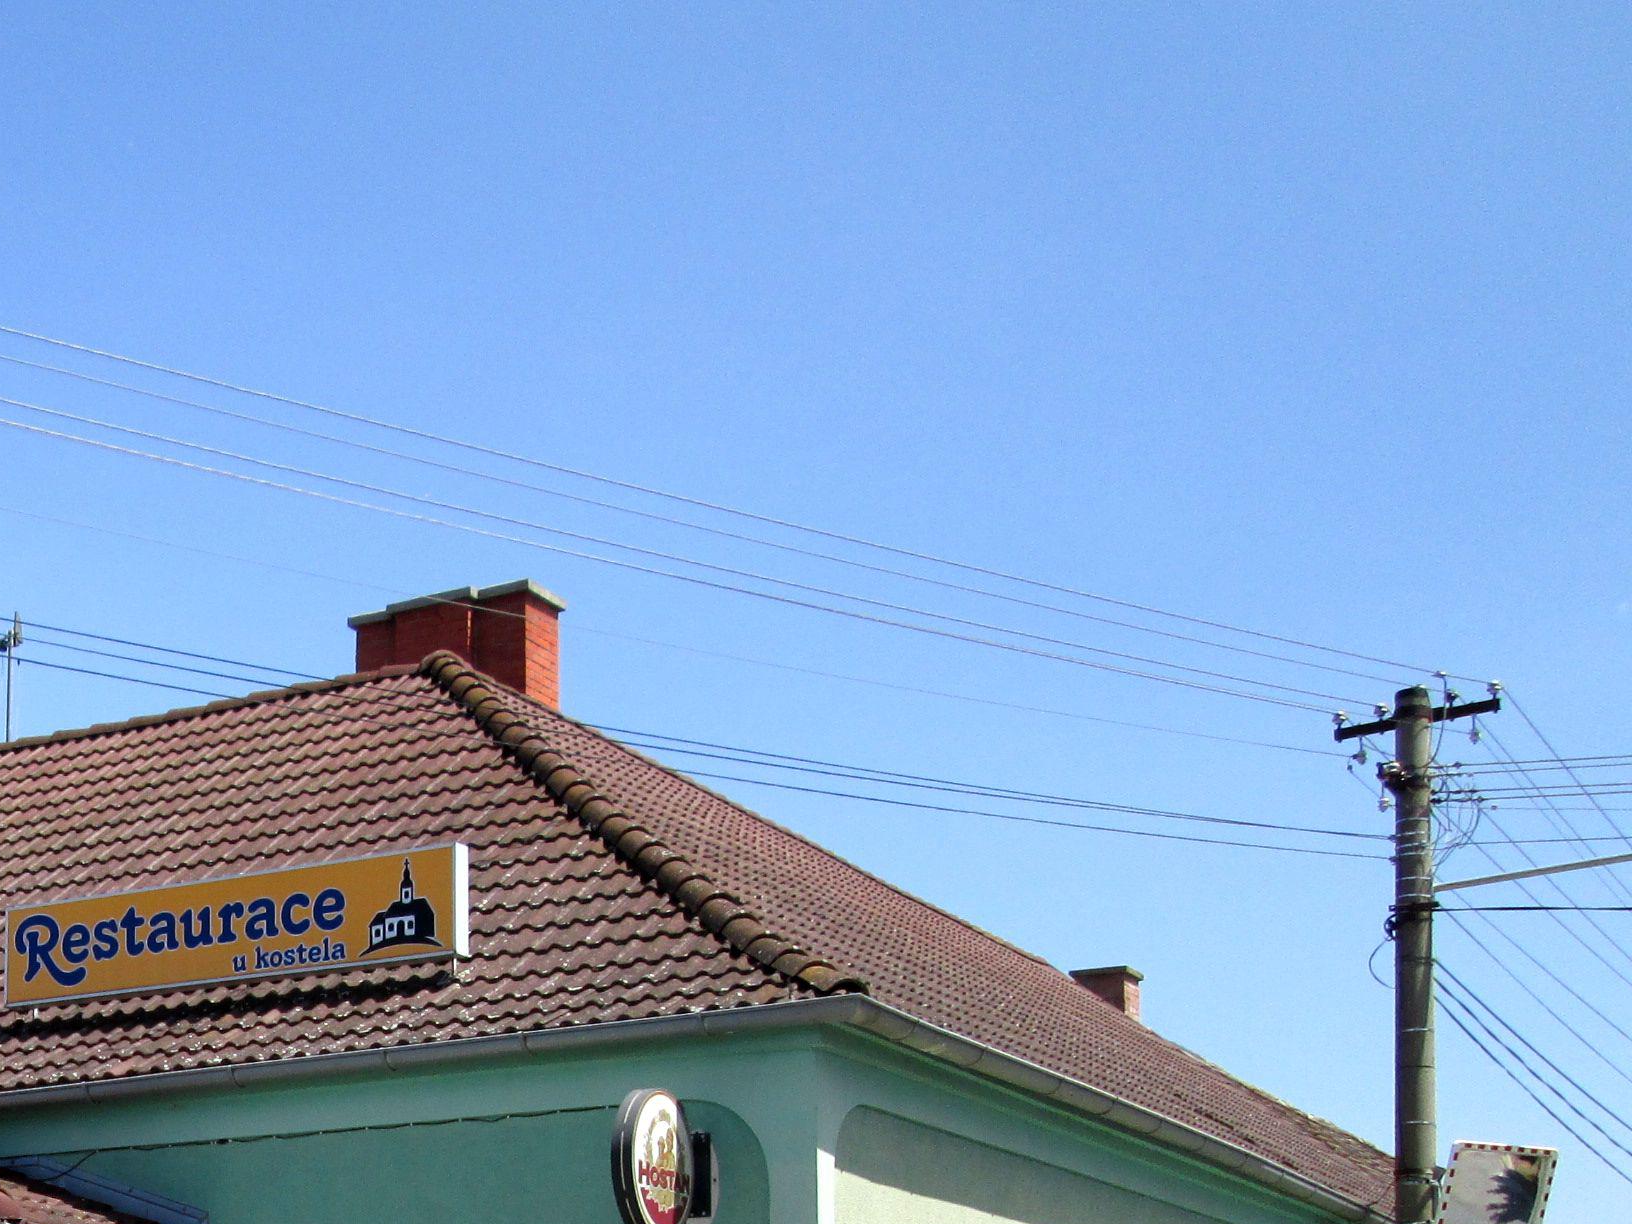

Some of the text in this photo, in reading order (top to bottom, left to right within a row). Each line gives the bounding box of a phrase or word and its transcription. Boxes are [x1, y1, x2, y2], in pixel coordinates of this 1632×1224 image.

[14, 887, 347, 988] Restaurace
[232, 939, 346, 973] u kostela
[638, 1159, 690, 1194] HOSTAN
